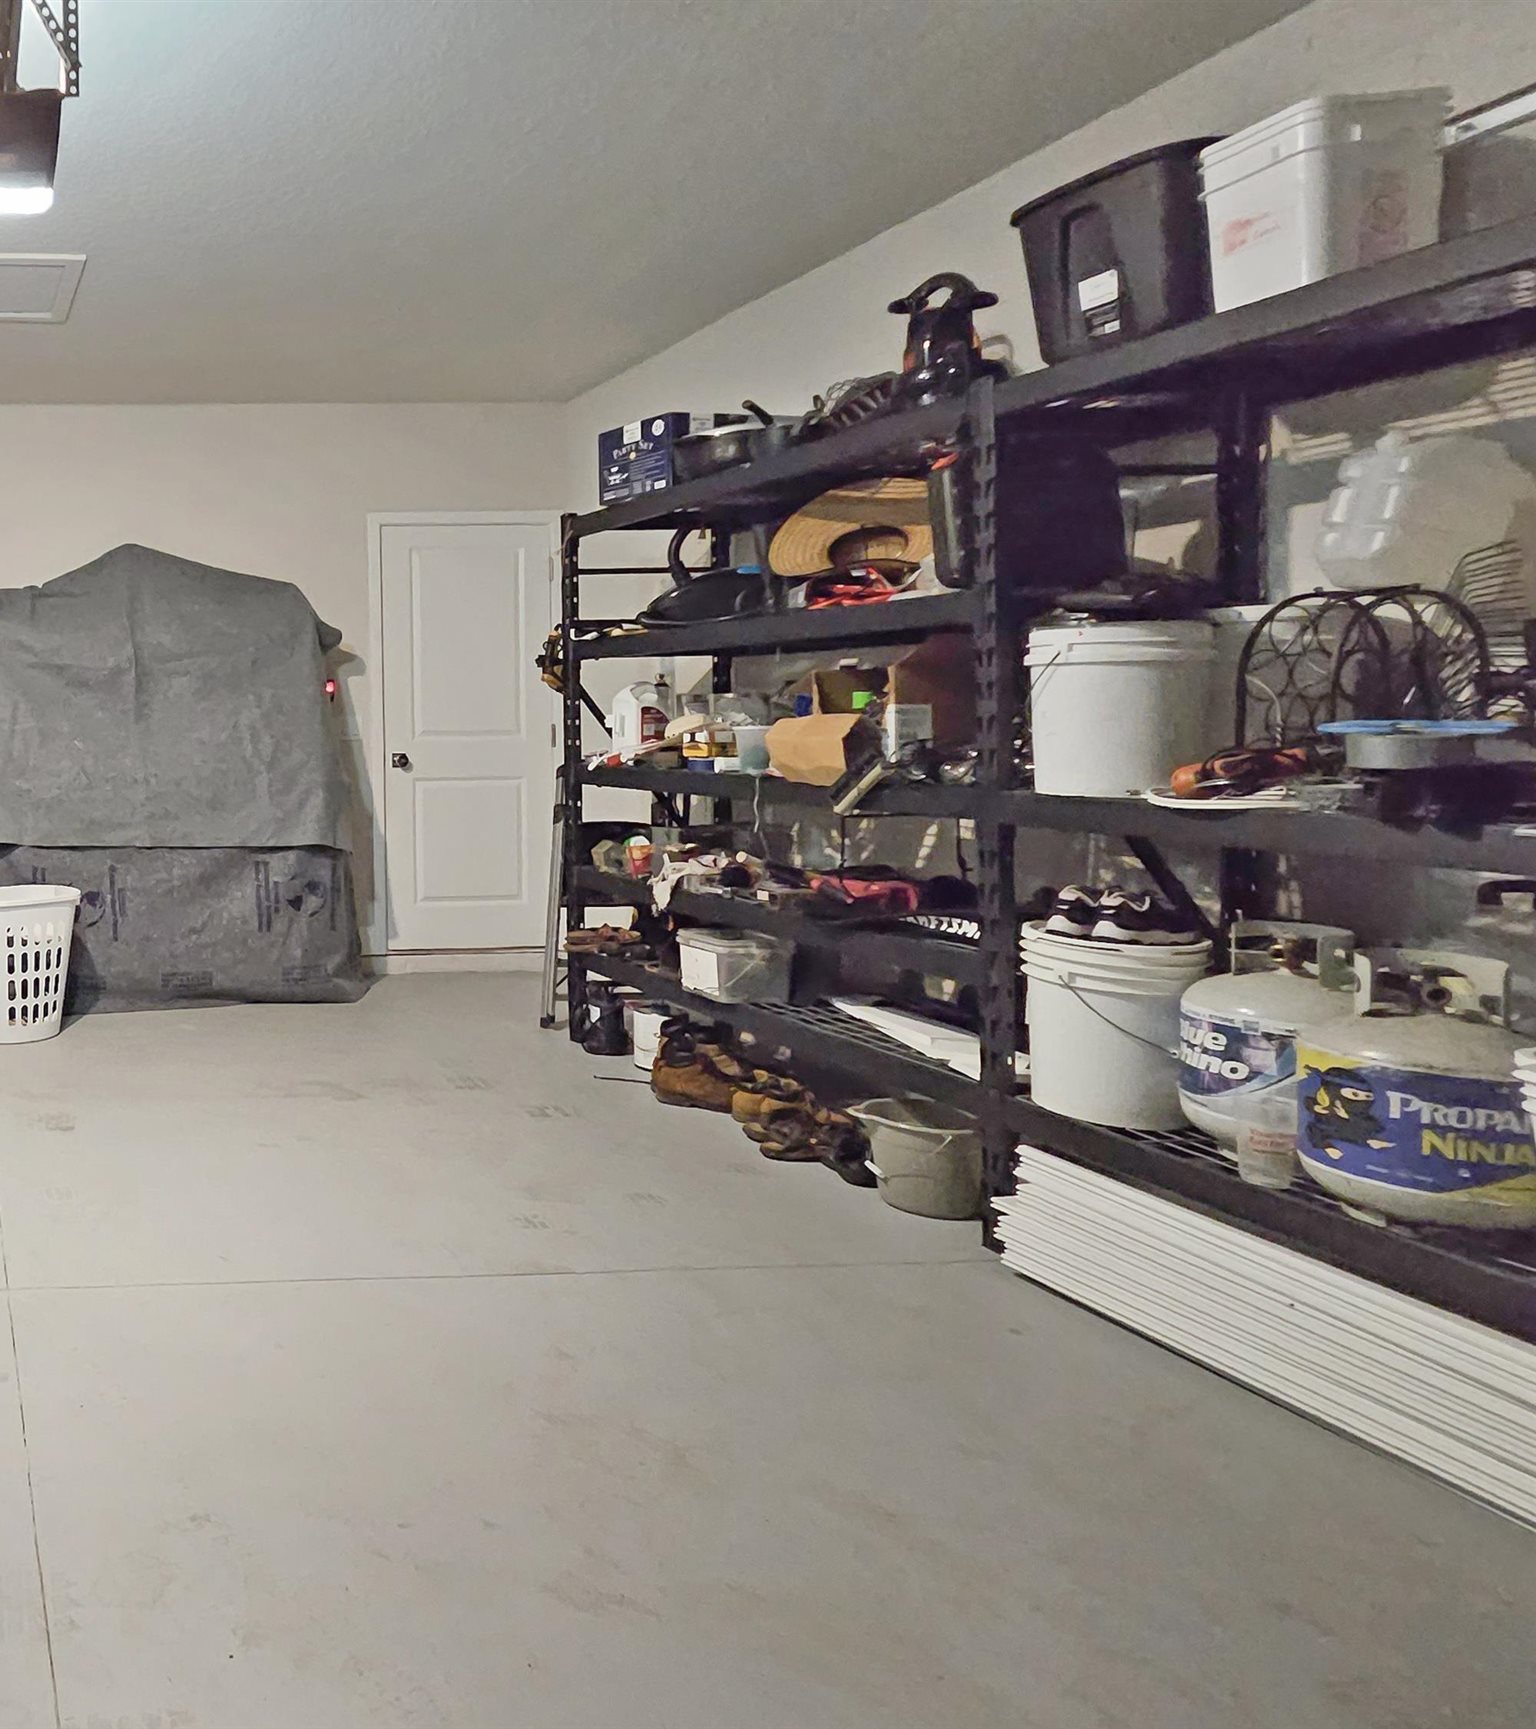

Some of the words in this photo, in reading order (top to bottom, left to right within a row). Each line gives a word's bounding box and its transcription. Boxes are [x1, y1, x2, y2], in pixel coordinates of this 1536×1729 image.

[1180, 1018, 1228, 1052] lue
[1180, 1041, 1251, 1081] hino
[1421, 1128, 1536, 1167] NINJA
